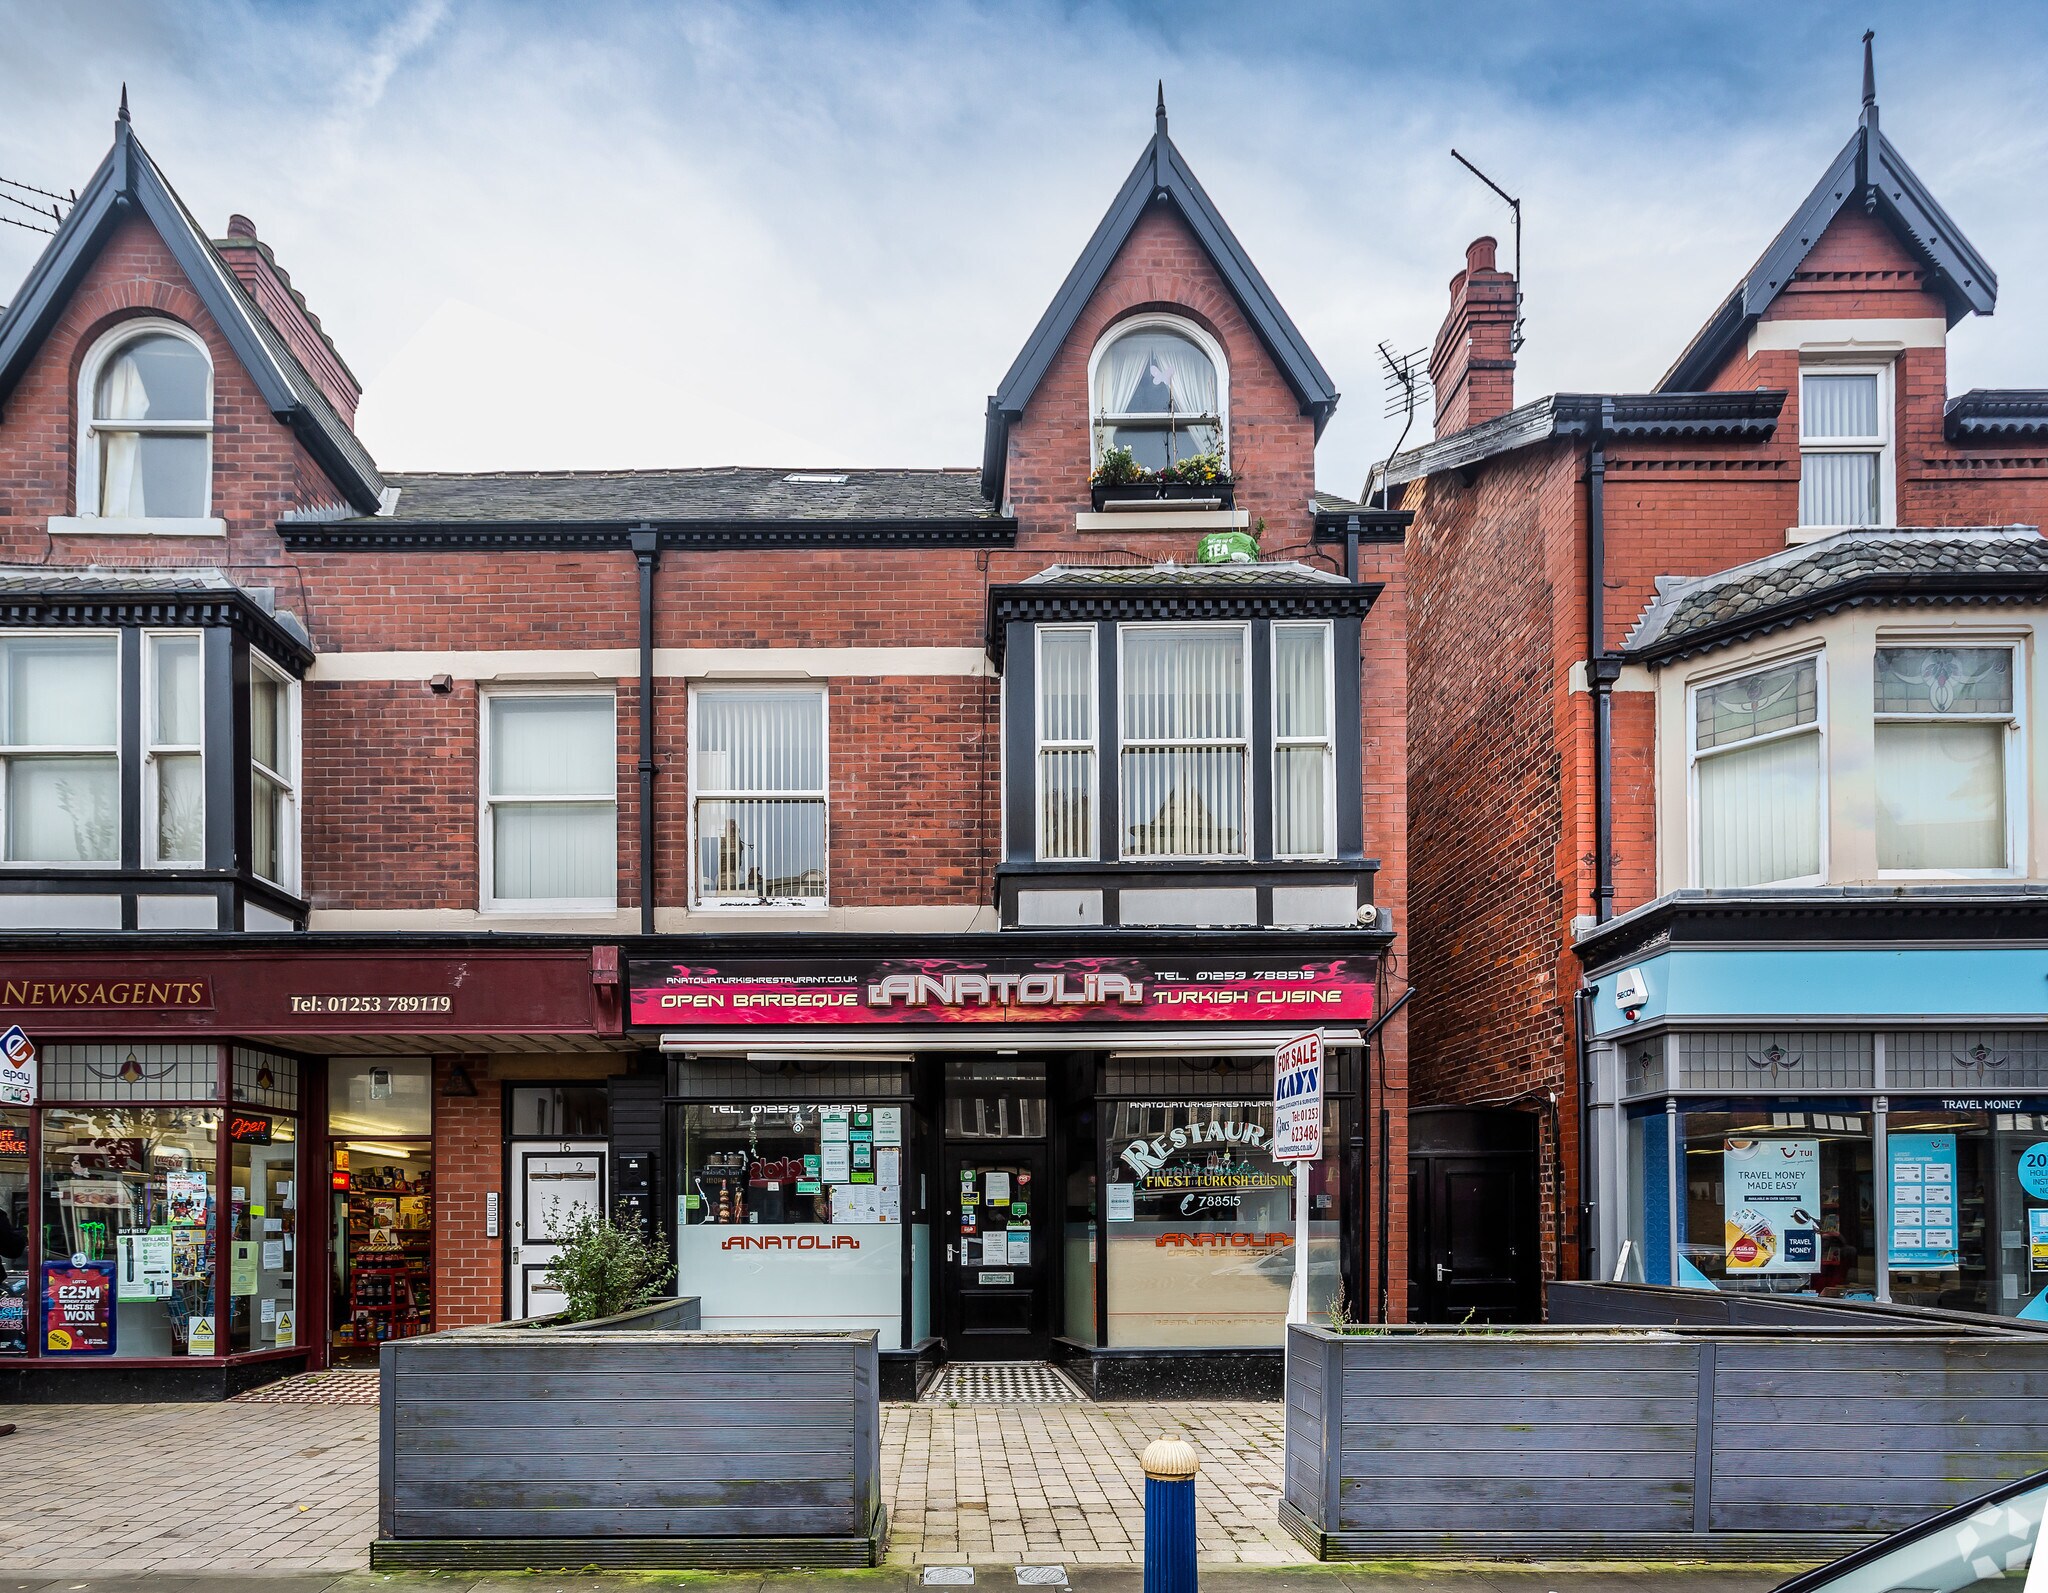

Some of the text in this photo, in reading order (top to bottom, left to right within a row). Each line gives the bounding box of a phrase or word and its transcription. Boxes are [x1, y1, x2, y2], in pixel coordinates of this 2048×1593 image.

[1207, 544, 1228, 558] TEA
[1154, 970, 1315, 981] TEL. 01253 788515
[291, 996, 451, 1012] Tel: 01253 789119
[661, 994, 858, 1008] OPEN BARBEQUE
[1152, 990, 1342, 1004] TURKISH CUISINE
[1278, 1041, 1317, 1074] FOR SALE
[2, 1068, 31, 1085] epay
[1276, 1067, 1319, 1101] KAYS
[709, 1104, 868, 1114] TEL. 01253 788515
[1942, 1100, 2022, 1109] TRAVEL MONEY
[1300, 1107, 1319, 1121] 01253
[1291, 1124, 1318, 1142] 623486
[559, 1142, 571, 1152] 16
[544, 1162, 584, 1172] 1 2
[2026, 1153, 2048, 1168] 20
[1146, 1174, 1294, 1188] FINEST TURKISH CUISINE
[1738, 1171, 1806, 1179] TRAVEL MONEY
[1747, 1182, 1798, 1190] MADE EASY
[1198, 1196, 1242, 1207] 788515
[58, 1286, 100, 1299] £25M
[64, 1311, 95, 1321] WON
